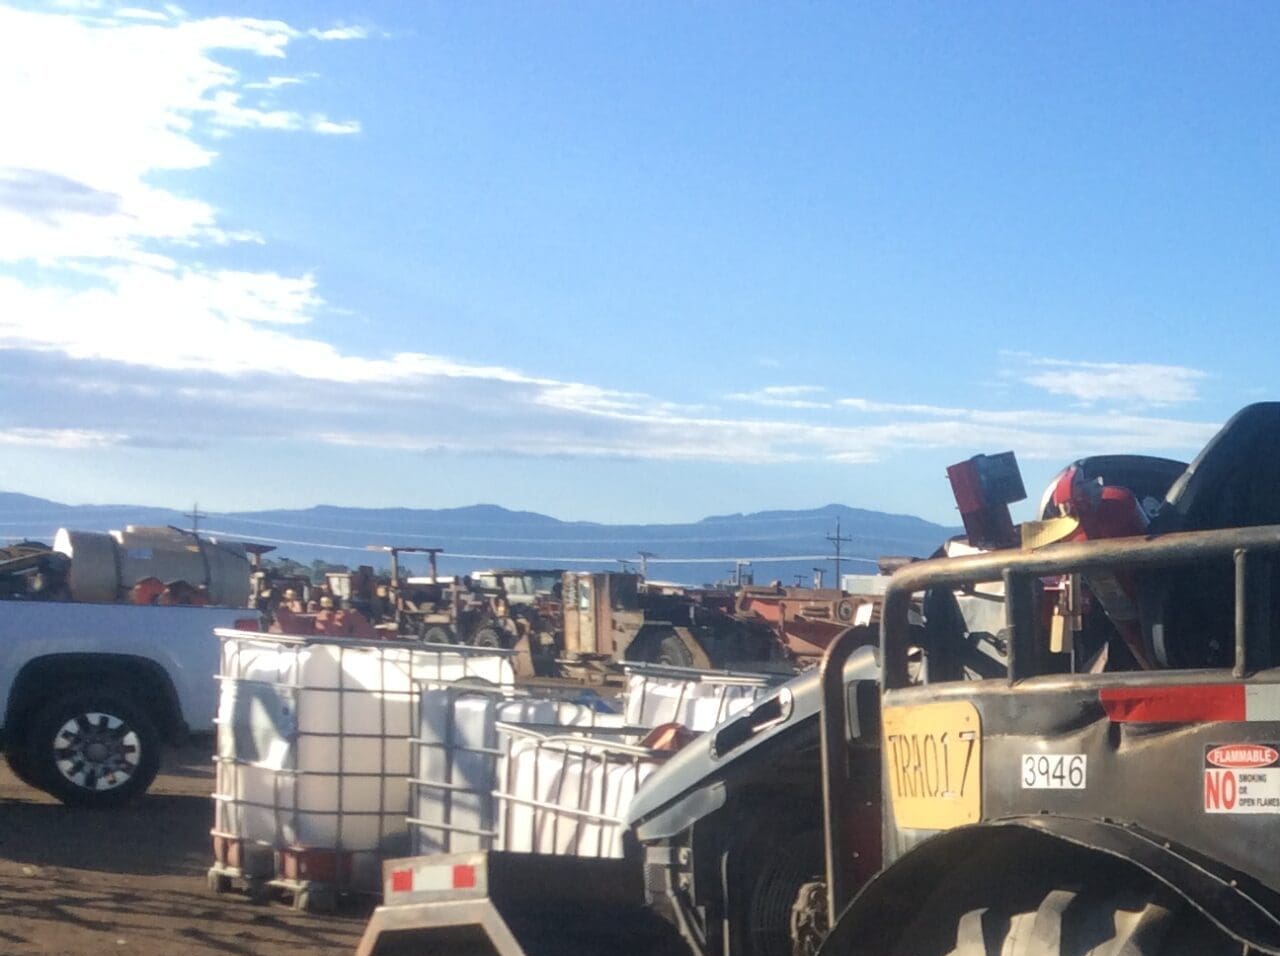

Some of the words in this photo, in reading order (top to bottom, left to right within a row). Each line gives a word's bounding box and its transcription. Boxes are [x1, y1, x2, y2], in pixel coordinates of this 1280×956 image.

[1213, 749, 1272, 764] FLAMMABLE
[1024, 756, 1084, 787] 3946
[1238, 774, 1268, 783] SMOKING
[1206, 770, 1236, 810] NO
[1238, 798, 1255, 807] OPEN
